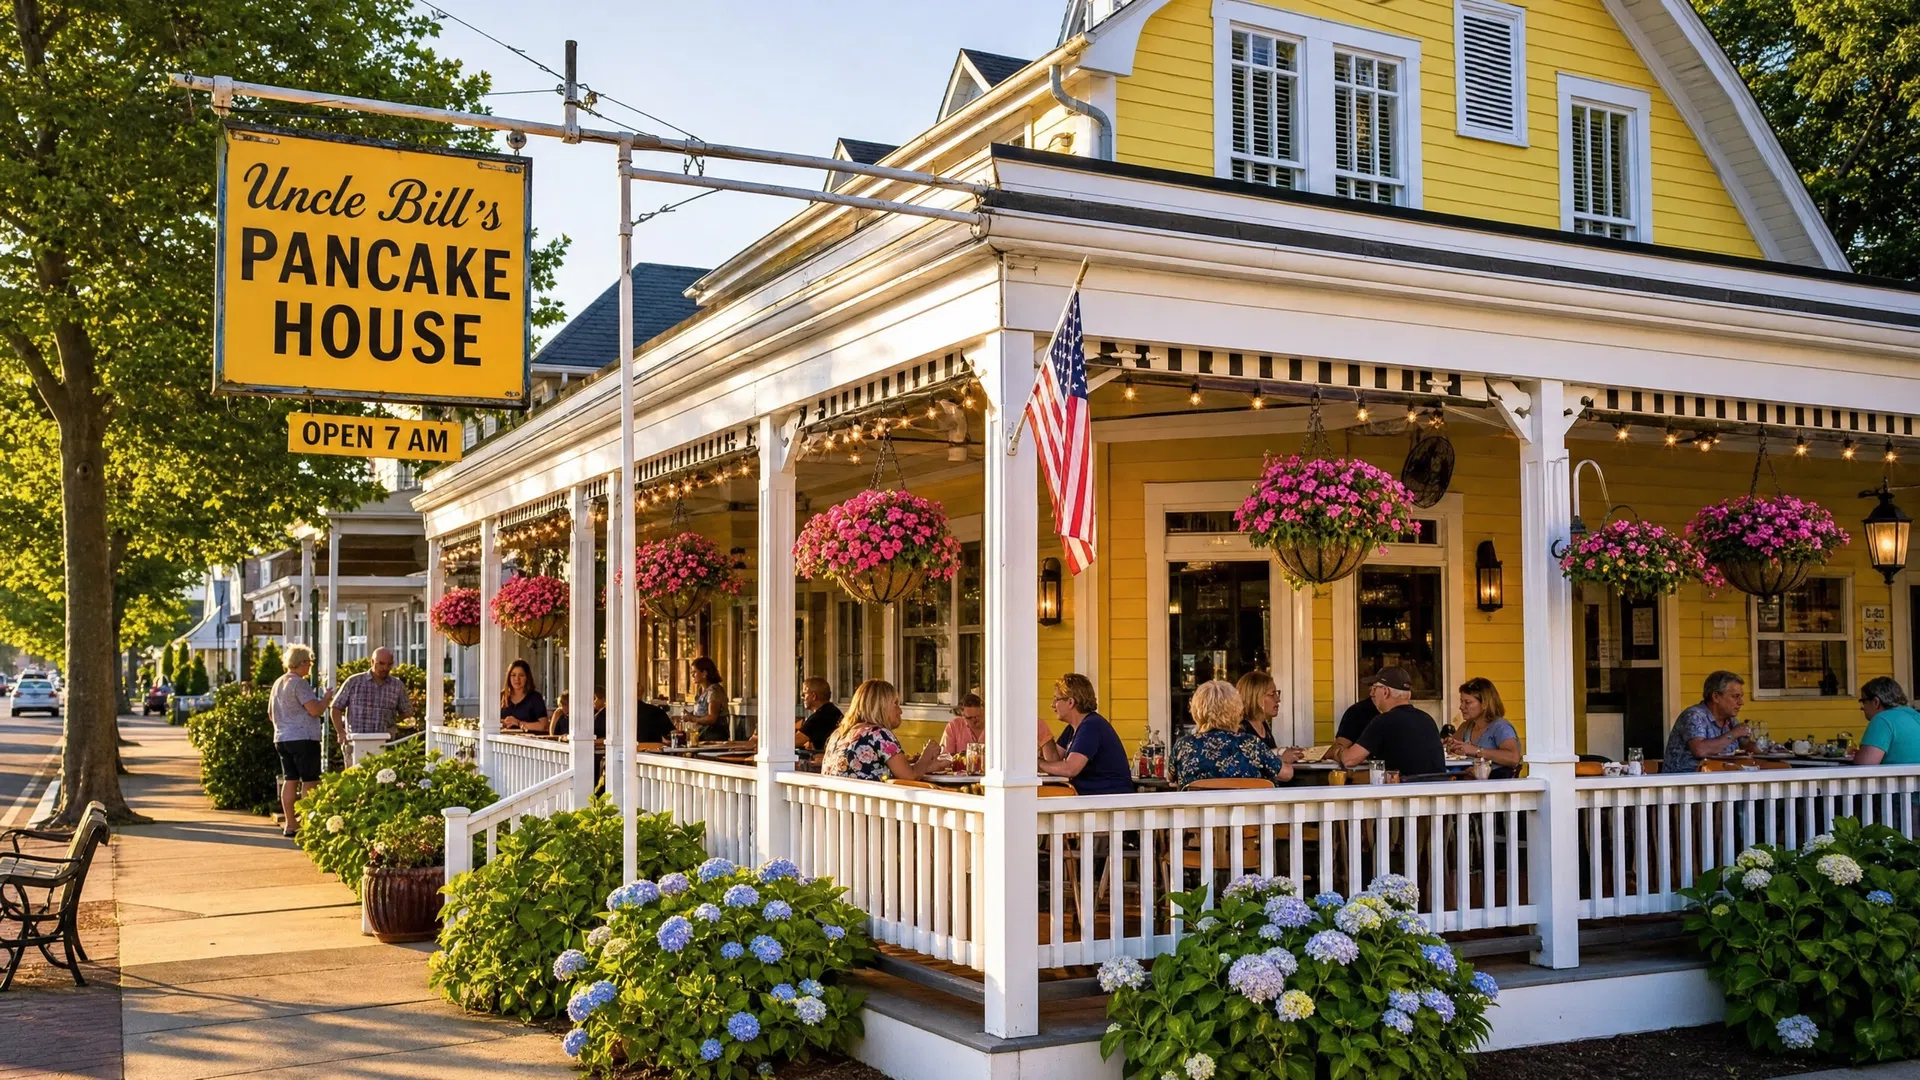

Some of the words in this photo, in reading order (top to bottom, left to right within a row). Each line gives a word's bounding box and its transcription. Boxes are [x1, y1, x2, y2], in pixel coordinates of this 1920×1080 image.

[243, 162, 366, 219] Uncle
[377, 178, 502, 231] Bill's
[241, 226, 511, 301] PANCAKE
[274, 300, 482, 367] HOUSE
[302, 421, 373, 449] OPEN
[384, 425, 401, 450] 7
[407, 428, 449, 453] AM
